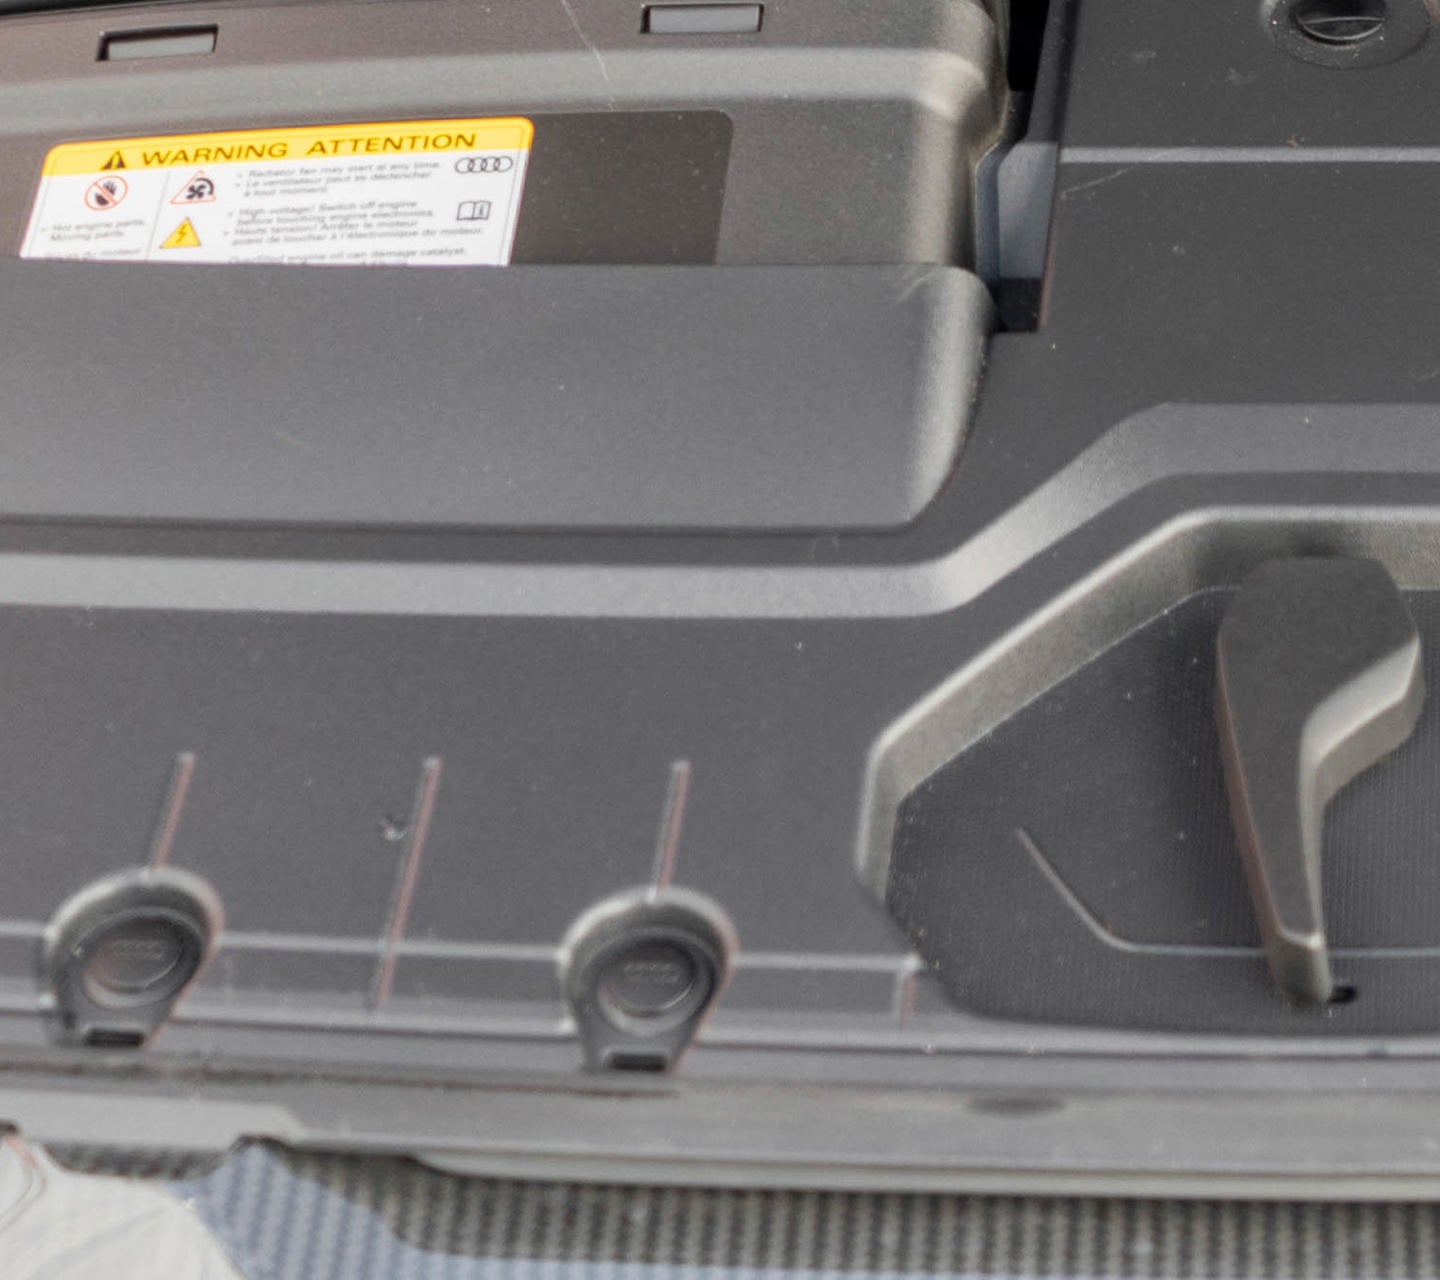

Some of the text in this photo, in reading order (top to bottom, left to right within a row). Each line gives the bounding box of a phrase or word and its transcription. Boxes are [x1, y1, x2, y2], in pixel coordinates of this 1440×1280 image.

[142, 133, 476, 166] WARNING ATTENTION
[321, 166, 343, 175] may
[347, 164, 373, 172] start
[390, 162, 409, 171] any
[378, 200, 417, 210] engine
[329, 212, 367, 221] engine
